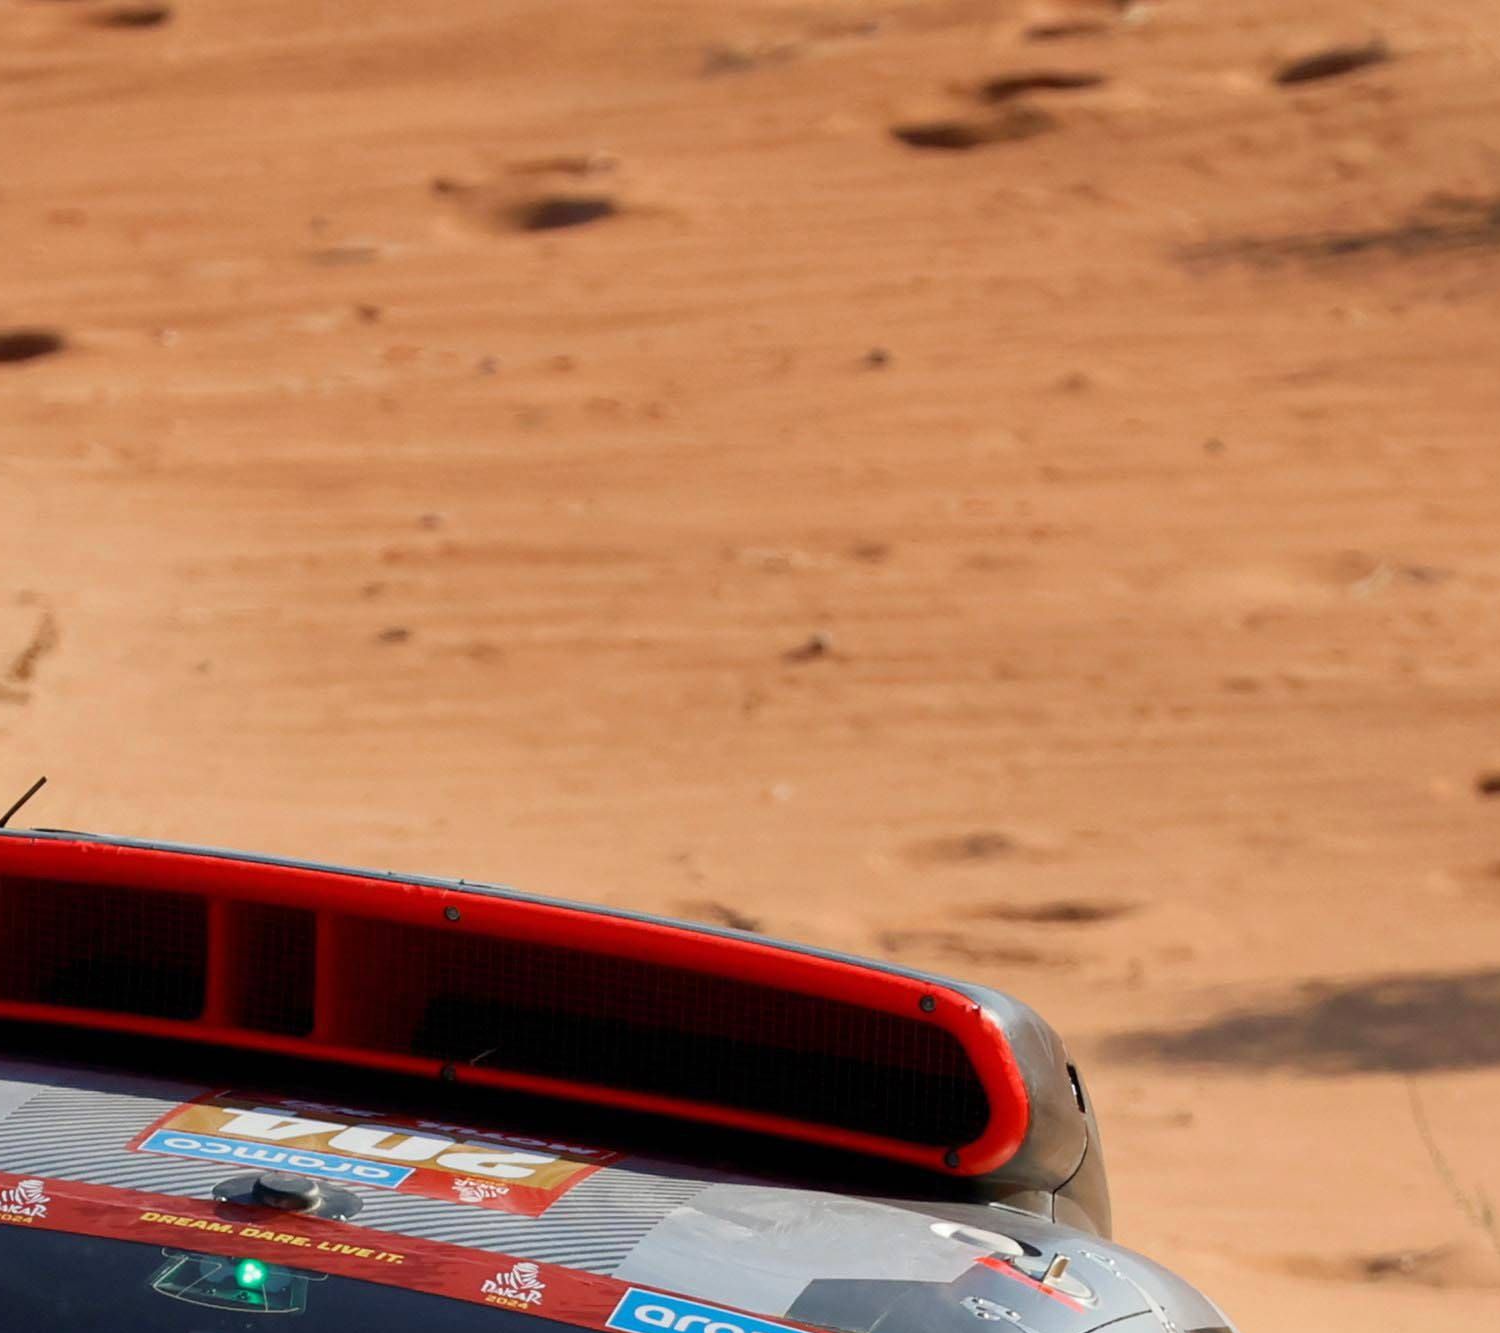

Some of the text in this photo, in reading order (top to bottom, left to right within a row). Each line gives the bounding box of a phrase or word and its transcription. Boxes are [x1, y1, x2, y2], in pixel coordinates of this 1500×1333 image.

[163, 1137, 391, 1181] aramco
[220, 1107, 560, 1178] 204
[140, 1211, 404, 1265] DREAM. DARE. LIVE IT.
[481, 1279, 543, 1305] DAKAR
[485, 1294, 528, 1309] 2024
